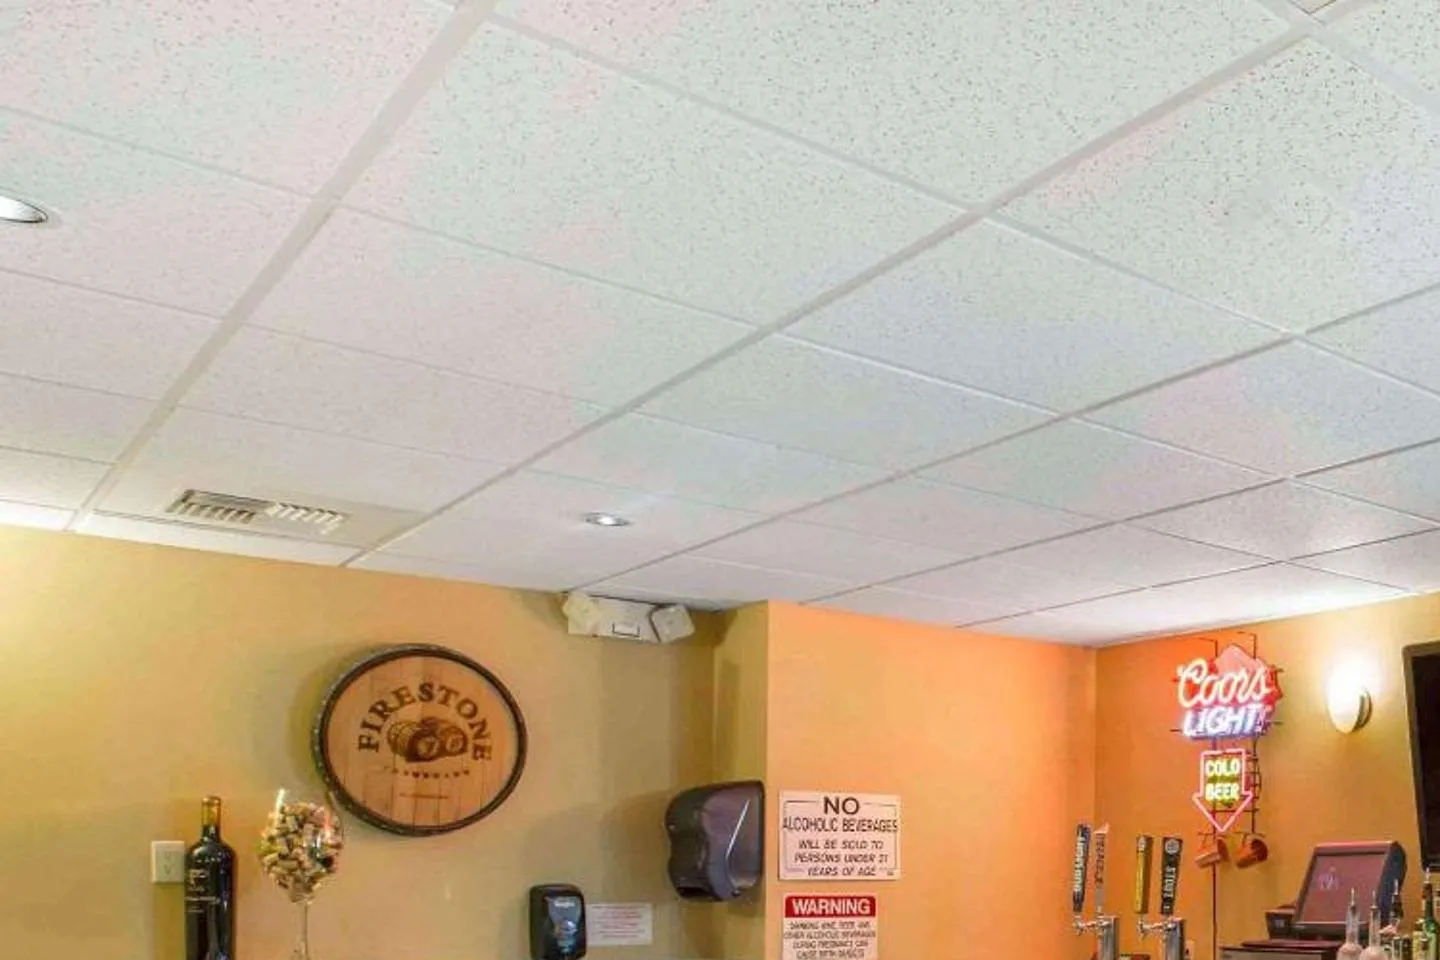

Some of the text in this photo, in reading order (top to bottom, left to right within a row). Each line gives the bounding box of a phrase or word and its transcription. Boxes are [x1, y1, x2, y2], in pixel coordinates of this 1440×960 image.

[1177, 657, 1273, 708] Coors
[358, 681, 492, 761] FIRESTONE
[1182, 703, 1268, 737] LIGHT
[1205, 758, 1240, 777] COLD
[1205, 783, 1240, 801] BEER
[823, 796, 860, 815] NO
[782, 816, 898, 833] ALCOHOLIC BEVERAGES
[799, 840, 884, 850] WILL BE SOLD TO
[794, 853, 840, 863] PERSONS
[844, 853, 876, 863] UNDER
[807, 867, 838, 877] YEARS
[842, 867, 855, 877] OF
[858, 867, 876, 877] AGE
[792, 898, 871, 915] WARNING
